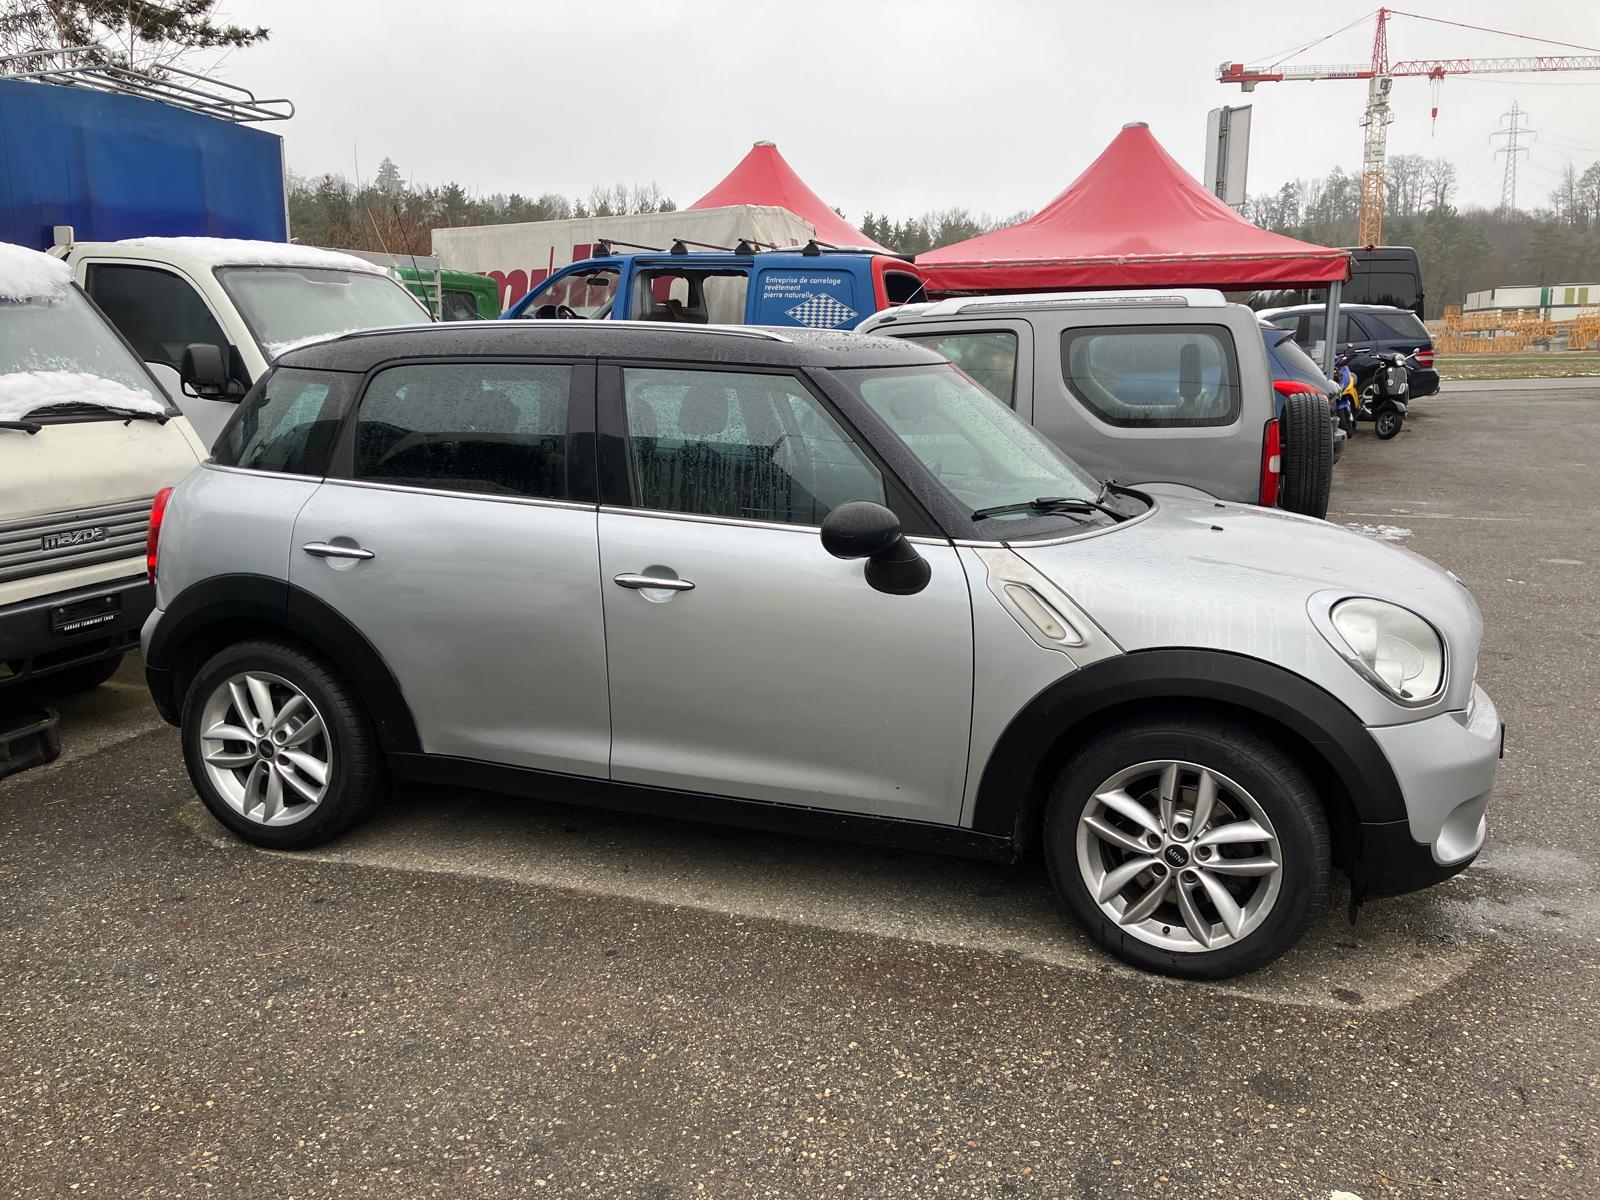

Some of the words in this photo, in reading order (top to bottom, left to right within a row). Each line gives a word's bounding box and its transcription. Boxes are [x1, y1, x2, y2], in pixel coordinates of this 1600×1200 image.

[765, 276, 798, 285] Entreprise
[799, 276, 808, 284] de
[809, 277, 842, 286] carrelage
[763, 291, 783, 299] pierre
[64, 623, 80, 631] GARAGE
[1168, 848, 1185, 864] MINI
